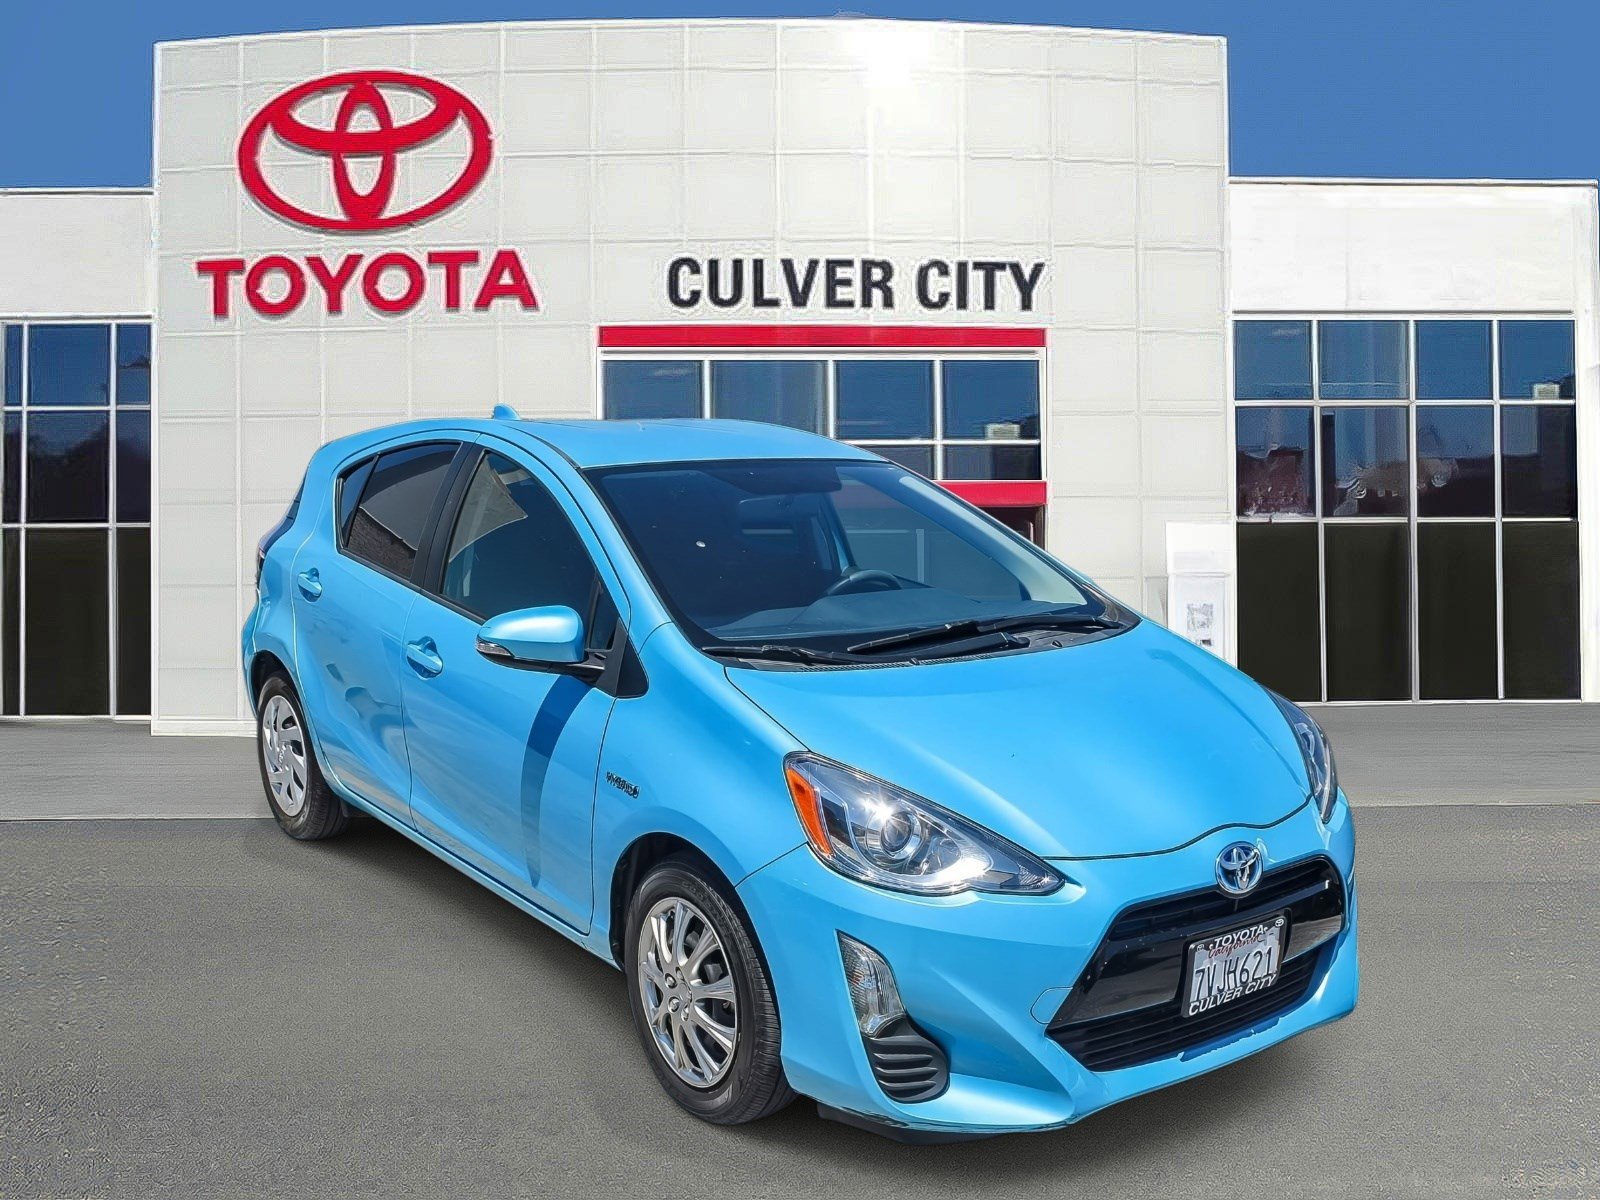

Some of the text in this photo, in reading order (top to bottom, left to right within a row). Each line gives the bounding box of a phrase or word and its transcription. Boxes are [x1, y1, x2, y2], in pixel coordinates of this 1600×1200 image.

[196, 250, 539, 318] TOYOTA
[667, 257, 1045, 311] CULVER CITY
[1214, 925, 1264, 948] TOYOTA
[1189, 974, 1277, 1016] CULVER CITY
[1195, 946, 1272, 1001] 7VJH621
